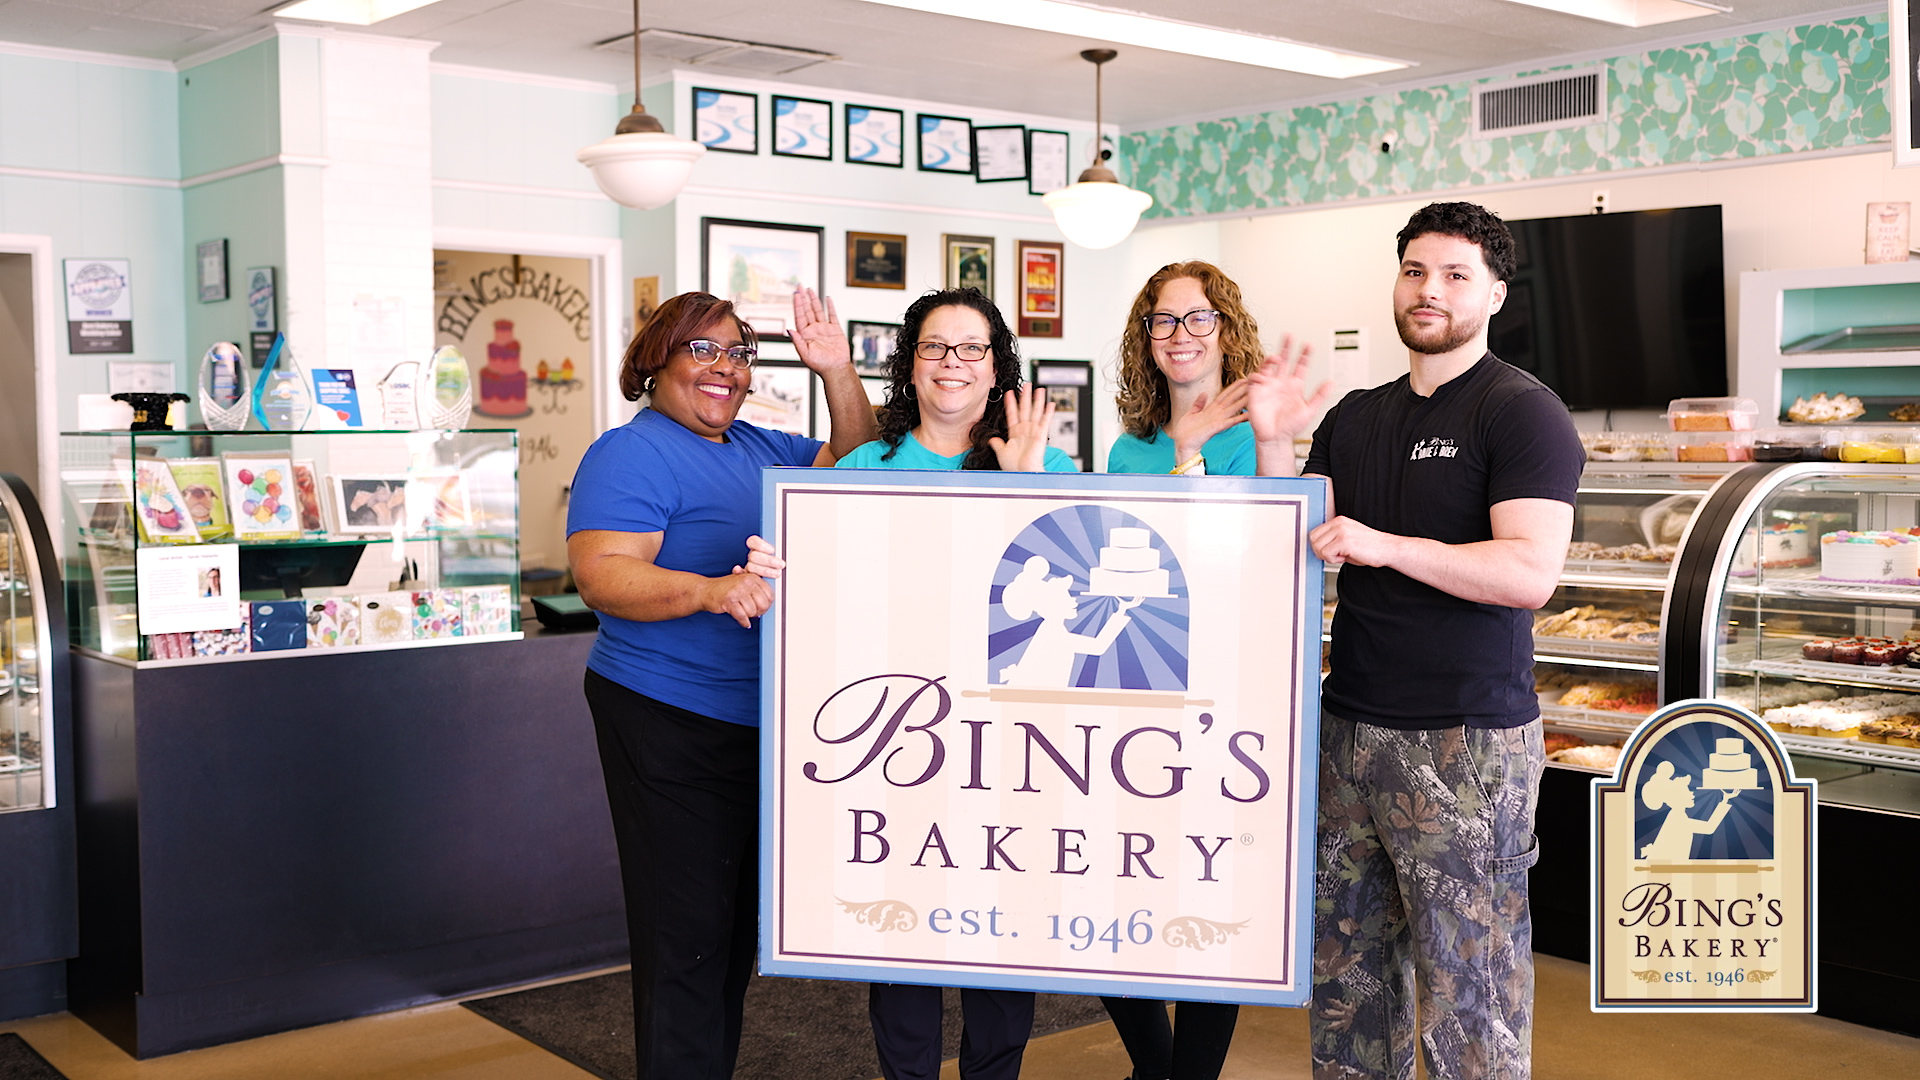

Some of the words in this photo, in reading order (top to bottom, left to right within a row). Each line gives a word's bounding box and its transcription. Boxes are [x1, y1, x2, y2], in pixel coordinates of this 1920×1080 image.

[519, 433, 560, 465] 1946
[803, 674, 1270, 803] BING'S
[846, 808, 1233, 882] BAKERY
[928, 905, 1019, 938] est.
[1047, 909, 1153, 954] 1946
